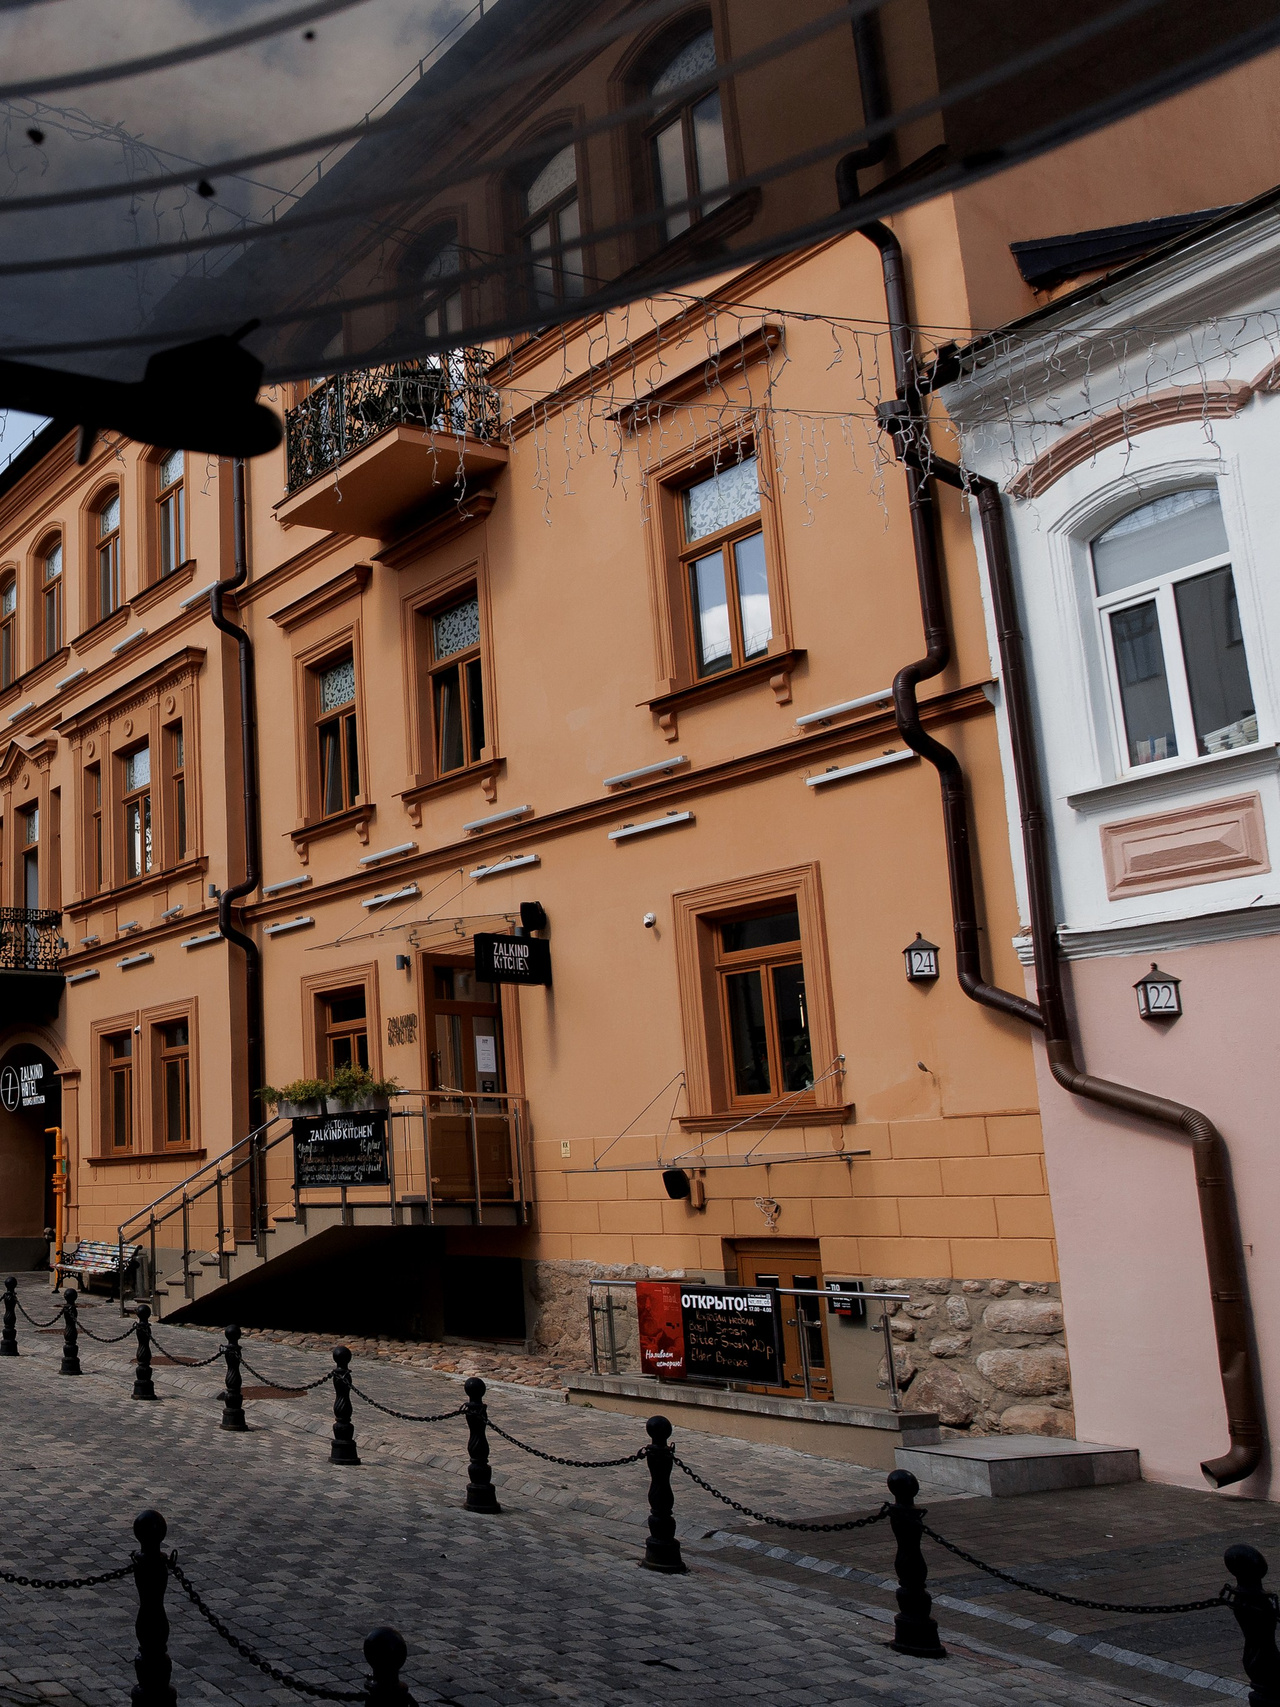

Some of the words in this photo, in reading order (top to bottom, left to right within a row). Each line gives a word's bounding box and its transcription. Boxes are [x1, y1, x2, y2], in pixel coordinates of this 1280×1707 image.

[493, 942, 529, 958] ZALKIND
[493, 956, 529, 971] KITCHEN
[913, 952, 934, 973] 24
[1149, 985, 1175, 1009] 22
[20, 1063, 44, 1081] ZALKIND
[21, 1080, 39, 1097] HOTEL
[681, 1294, 748, 1312] ОТКРЫТО!
[689, 1320, 708, 1333] Basil
[715, 1323, 747, 1337] Smash
[689, 1333, 718, 1346] Bitter
[720, 1335, 750, 1351] Smash
[645, 1349, 674, 1360] Наливаем
